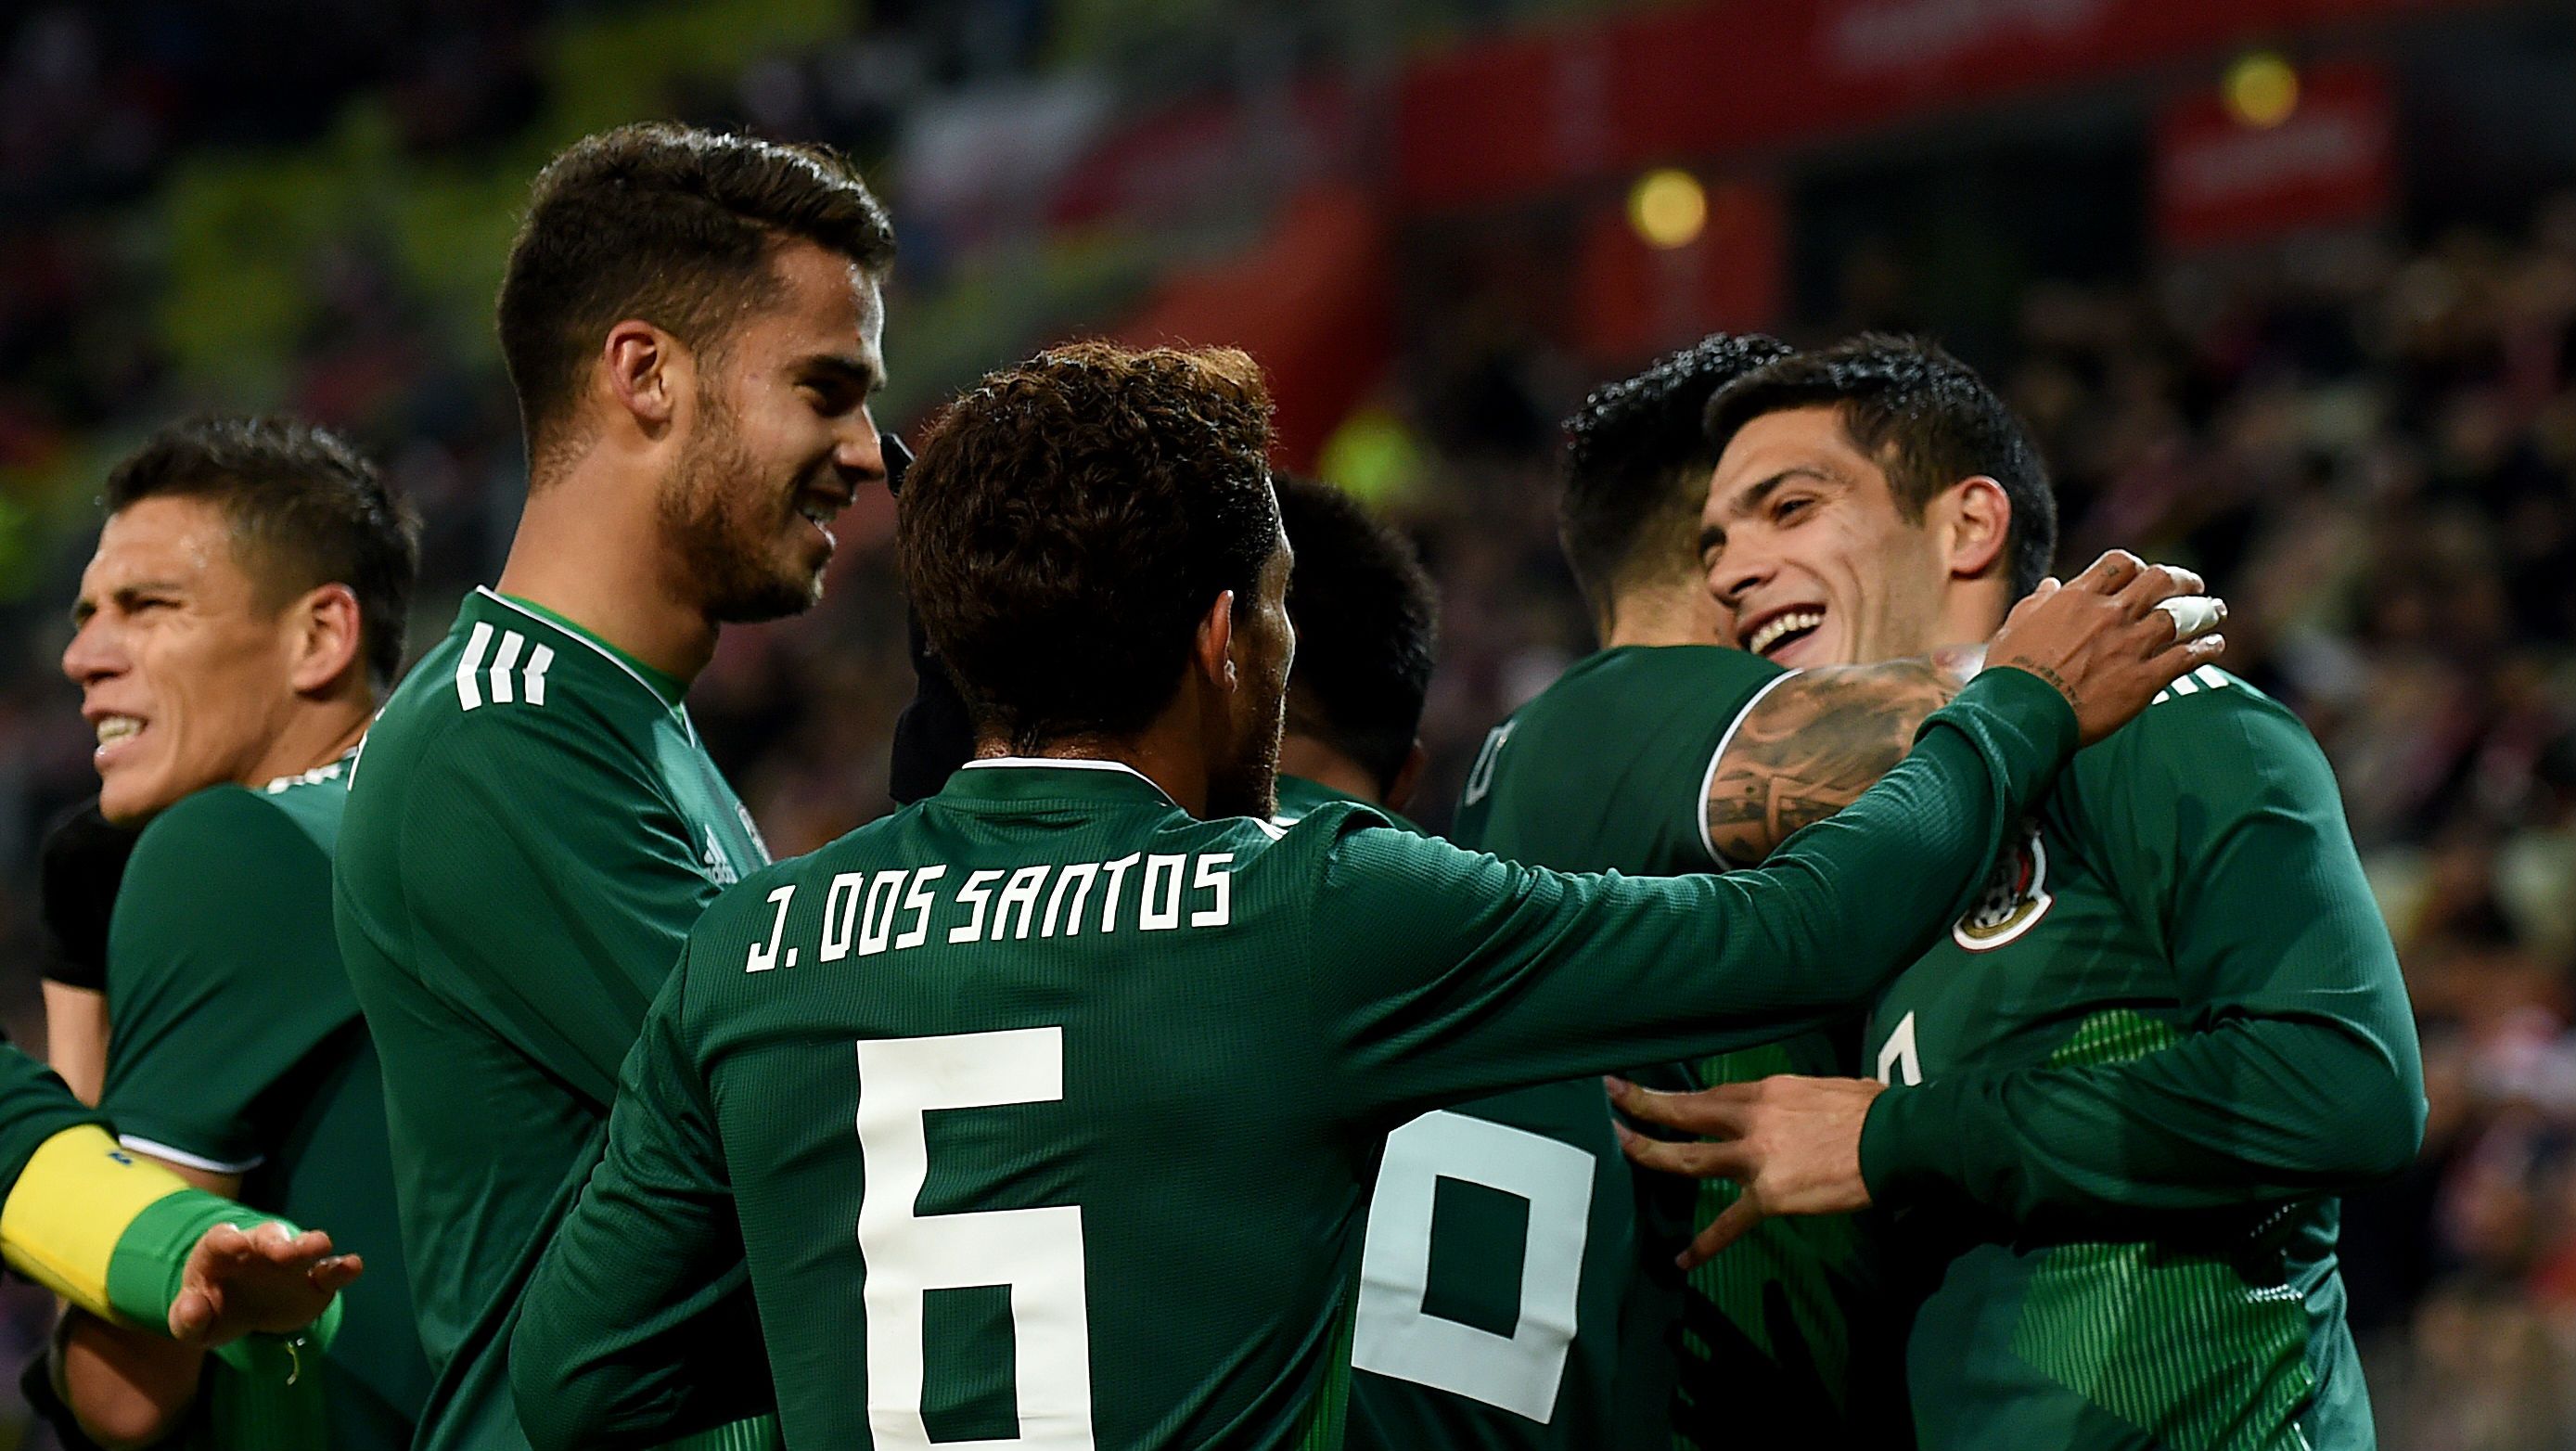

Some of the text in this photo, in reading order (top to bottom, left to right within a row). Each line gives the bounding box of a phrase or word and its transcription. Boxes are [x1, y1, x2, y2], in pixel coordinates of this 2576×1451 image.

[745, 851, 1235, 973] J. DOS SANTOS
[856, 1026, 1096, 1451] 6
